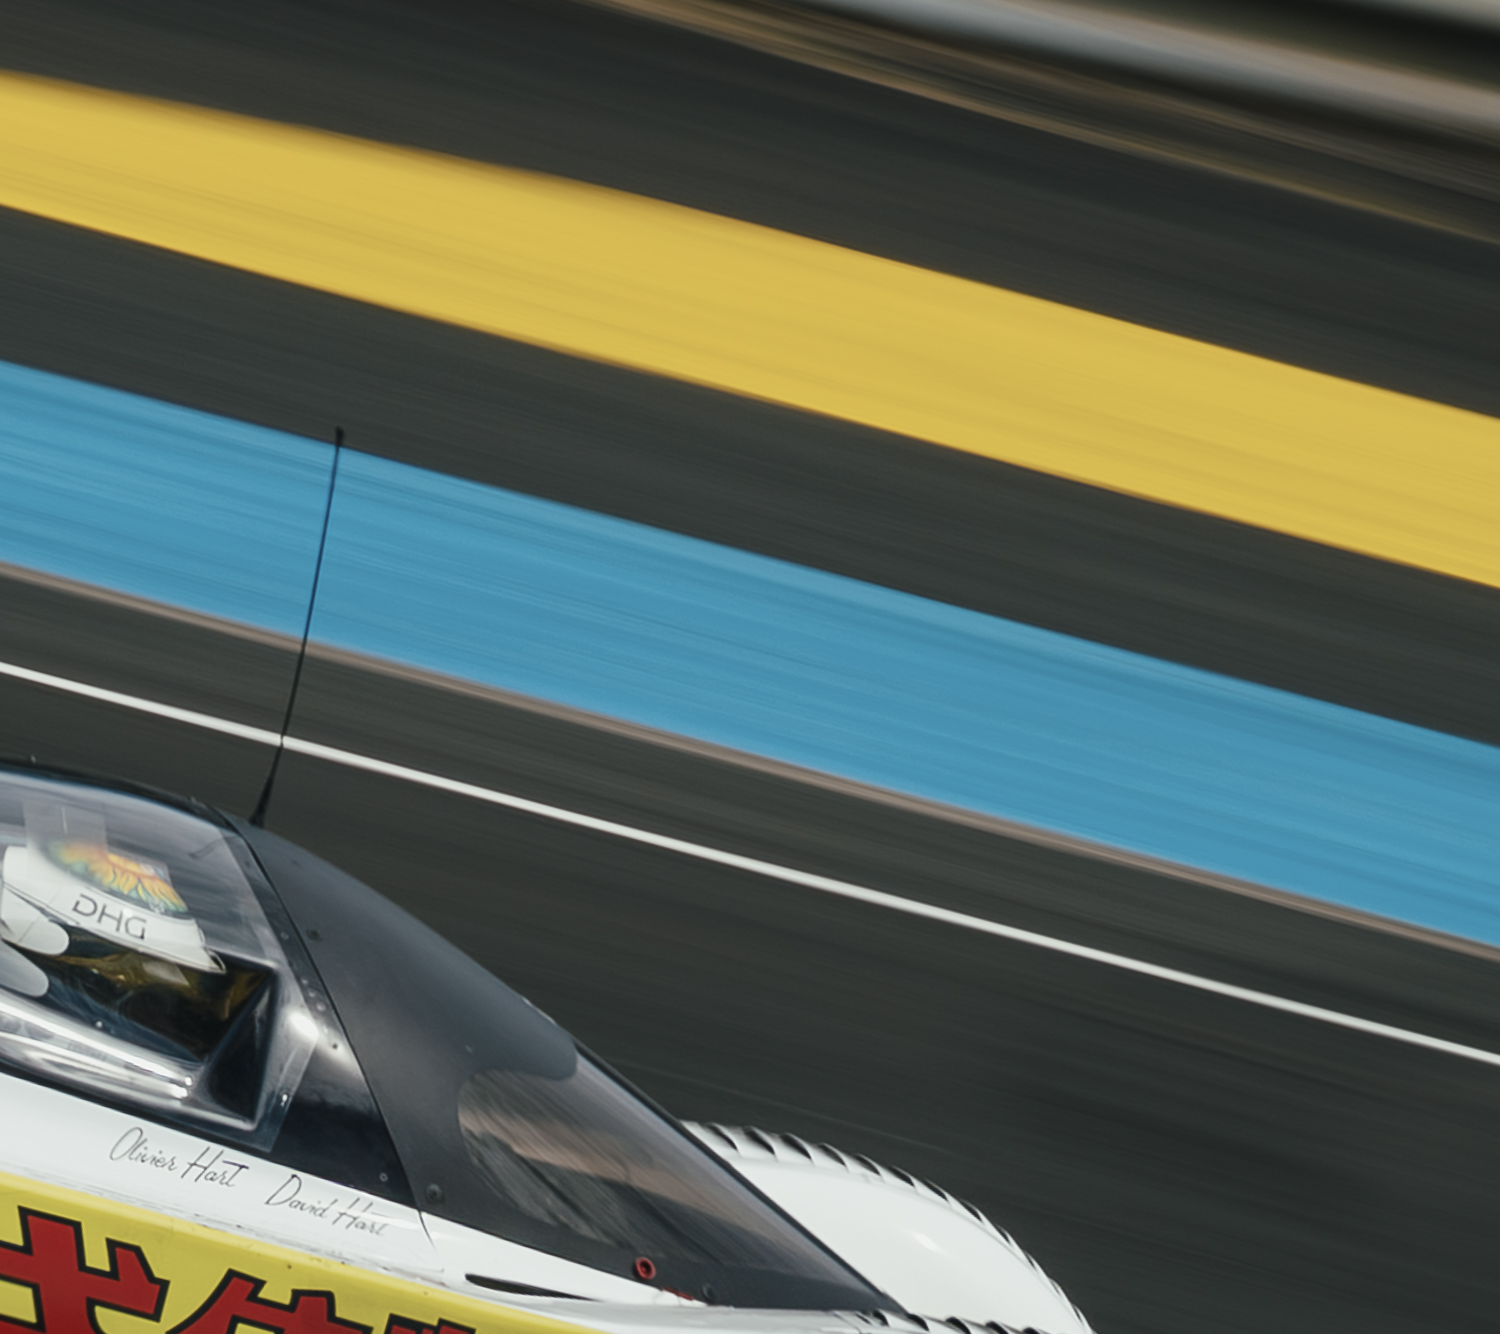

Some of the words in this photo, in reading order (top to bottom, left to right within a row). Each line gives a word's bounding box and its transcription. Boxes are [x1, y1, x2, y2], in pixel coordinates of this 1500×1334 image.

[72, 893, 147, 940] DHG
[109, 1127, 178, 1172] Olivier
[181, 1146, 249, 1187] Hart
[265, 1174, 338, 1219] David
